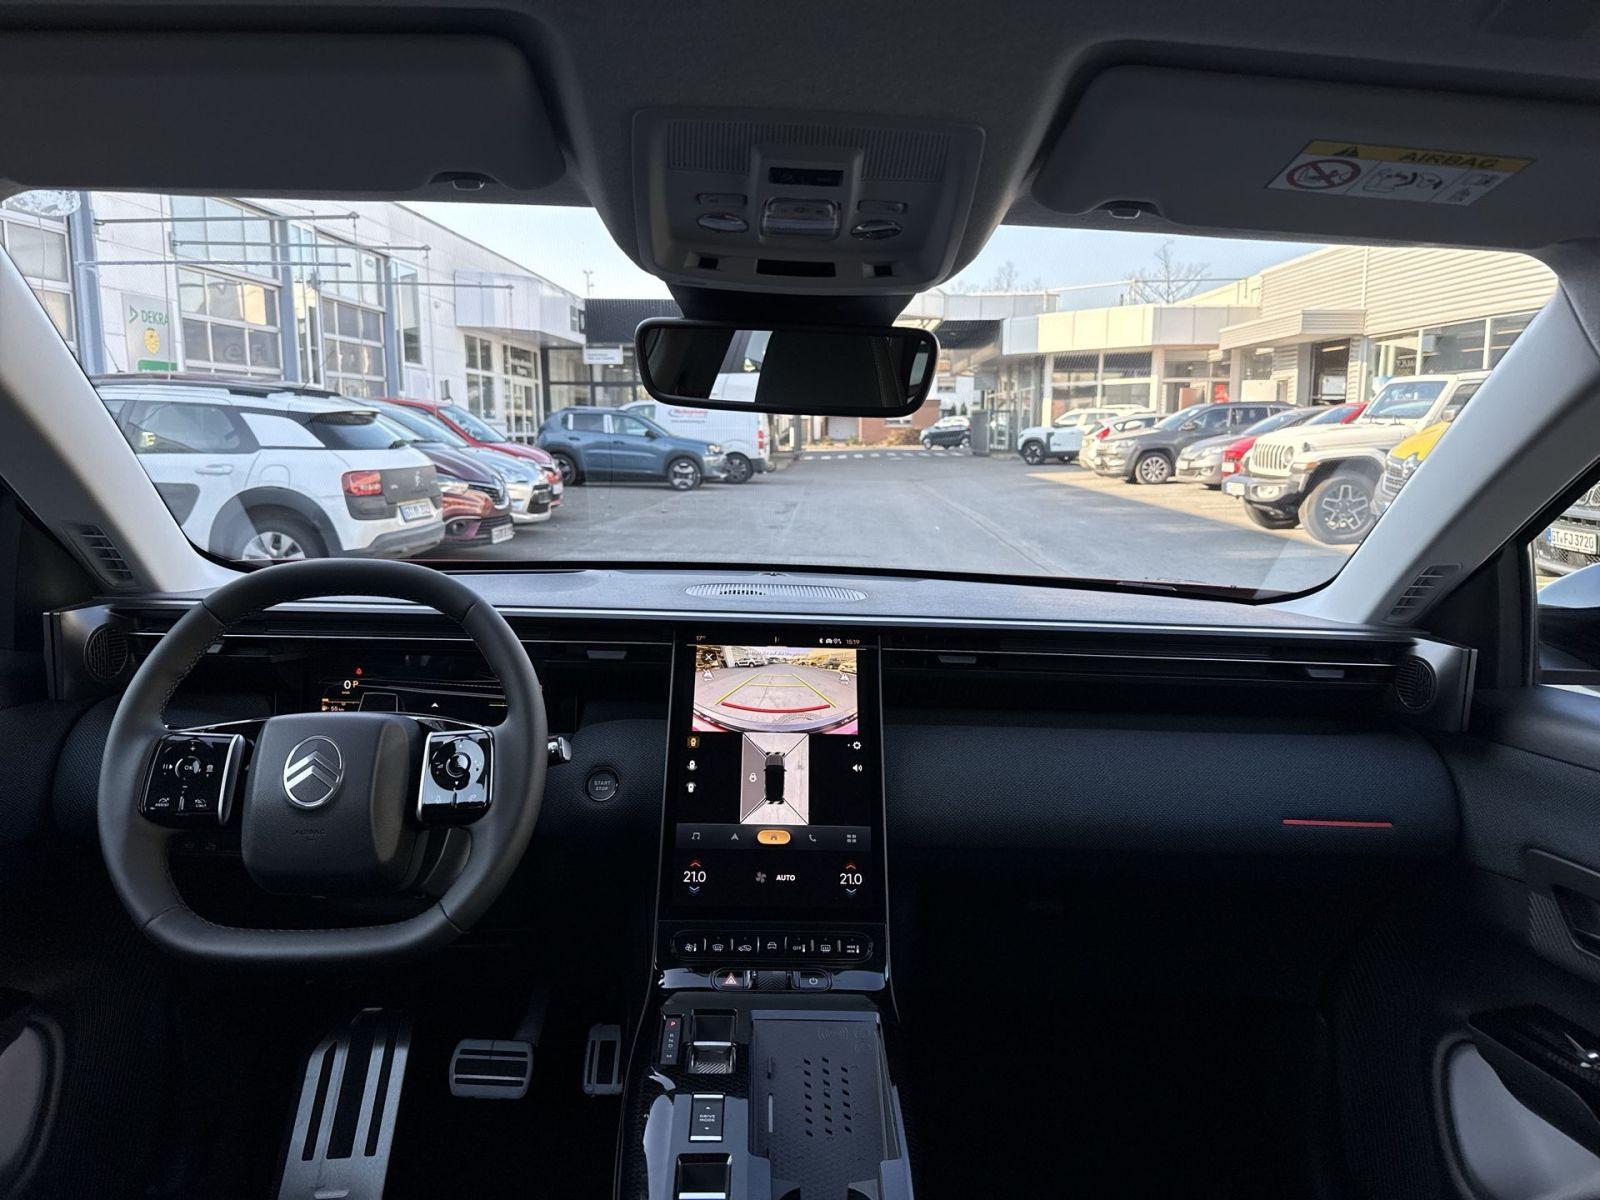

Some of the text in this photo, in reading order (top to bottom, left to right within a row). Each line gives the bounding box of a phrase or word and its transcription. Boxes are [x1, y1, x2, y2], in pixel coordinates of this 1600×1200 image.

[1399, 151, 1500, 169] AIRBAG
[141, 310, 169, 325] DEKRA
[683, 870, 706, 883] 21.0
[840, 873, 862, 885] 21.0
